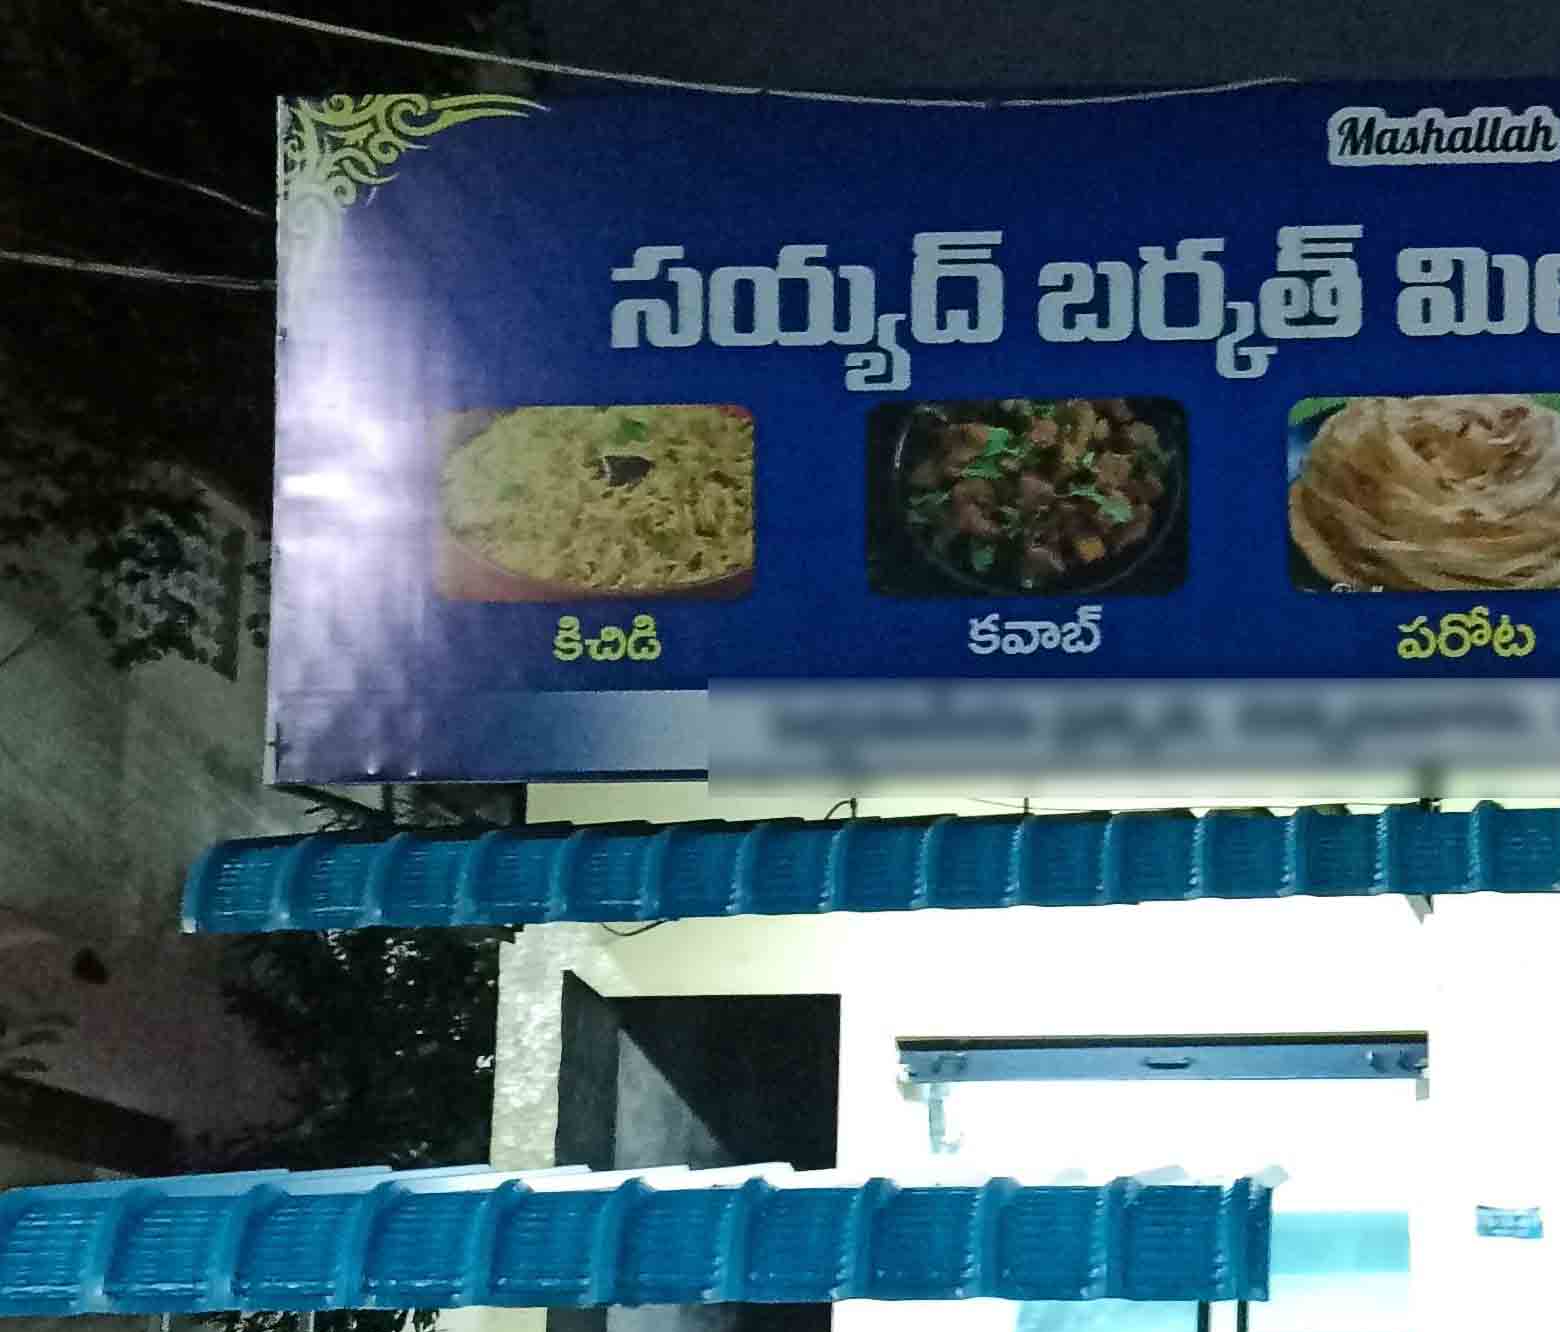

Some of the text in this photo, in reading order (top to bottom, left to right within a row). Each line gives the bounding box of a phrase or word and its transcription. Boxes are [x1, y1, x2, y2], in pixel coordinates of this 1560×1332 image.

[1337, 115, 1558, 156] Mashallah
[612, 231, 1004, 391] సయ్యద్
[1038, 225, 1363, 379] బర్కత్
[553, 614, 662, 661] కిచిడి
[968, 605, 1103, 655] కవాబ్
[1397, 605, 1536, 659] పరోట
